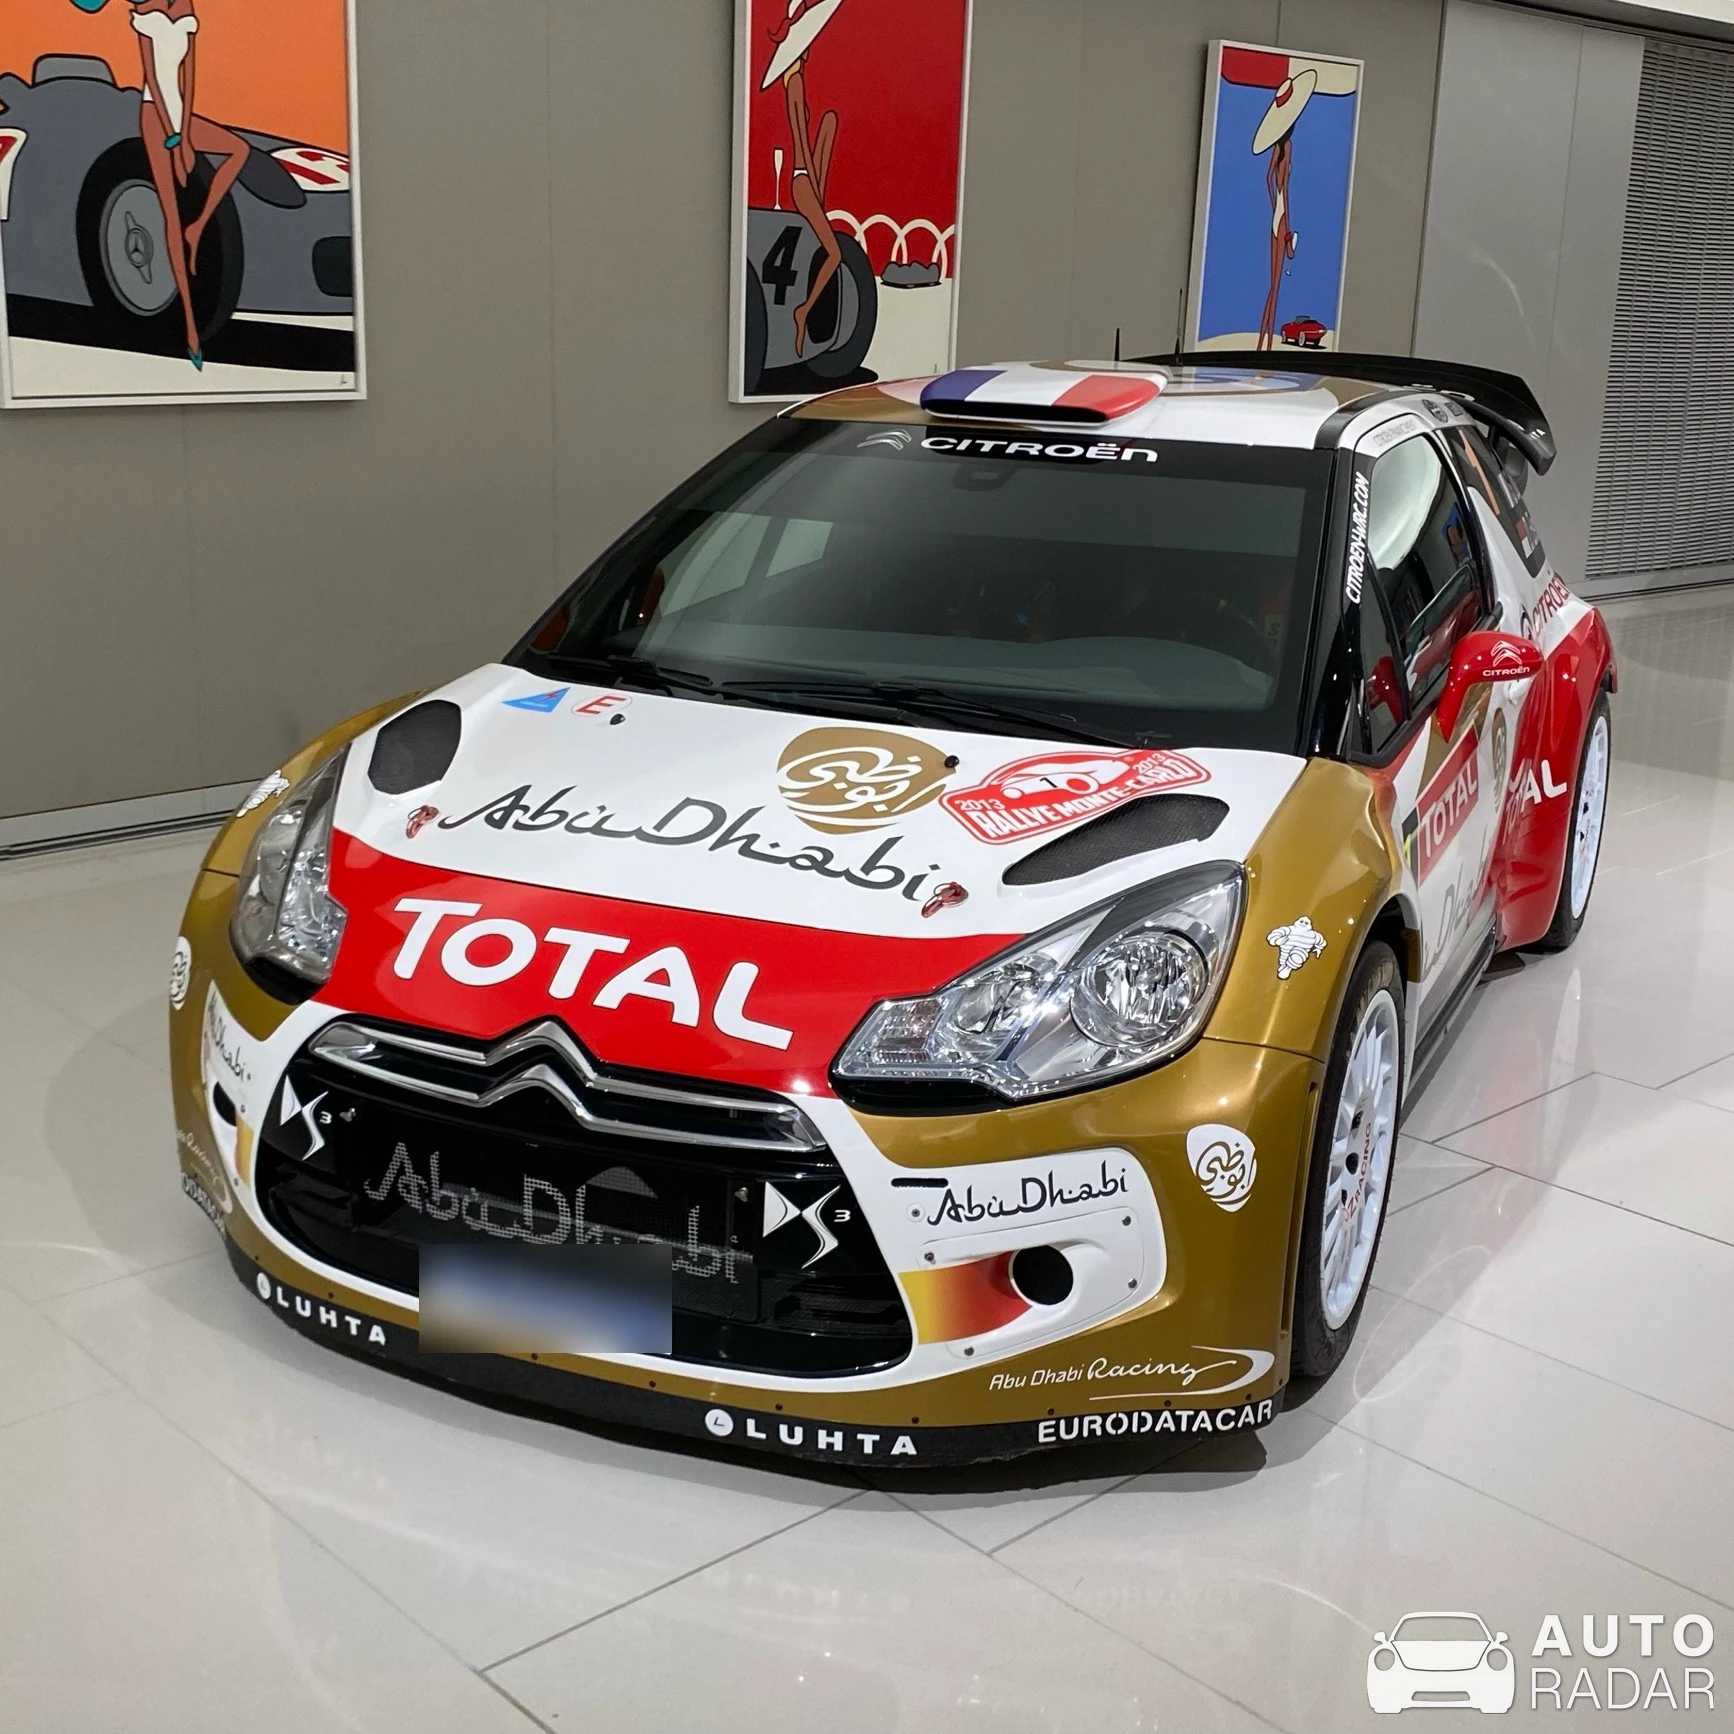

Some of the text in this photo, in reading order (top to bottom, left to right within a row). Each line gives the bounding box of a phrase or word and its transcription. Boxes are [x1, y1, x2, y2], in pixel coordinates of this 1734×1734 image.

[762, 225, 803, 306] 4
[1346, 471, 1370, 604] CITROEN-WRC.COM
[576, 695, 627, 715] E
[1131, 752, 1167, 774] 2013
[954, 798, 1006, 812] 2013
[966, 757, 1194, 838] RALLYE MONTE-CARLO
[1419, 758, 1478, 858] TOTAL
[393, 898, 794, 1051] TOTAL
[928, 1161, 1128, 1226] Abu Dhabi
[276, 1286, 386, 1346] LUHTA
[989, 1357, 1237, 1391] Abu Dhabi Racing
[746, 1418, 917, 1456] LUHTA
[1038, 1399, 1273, 1444] EURODATACAR
